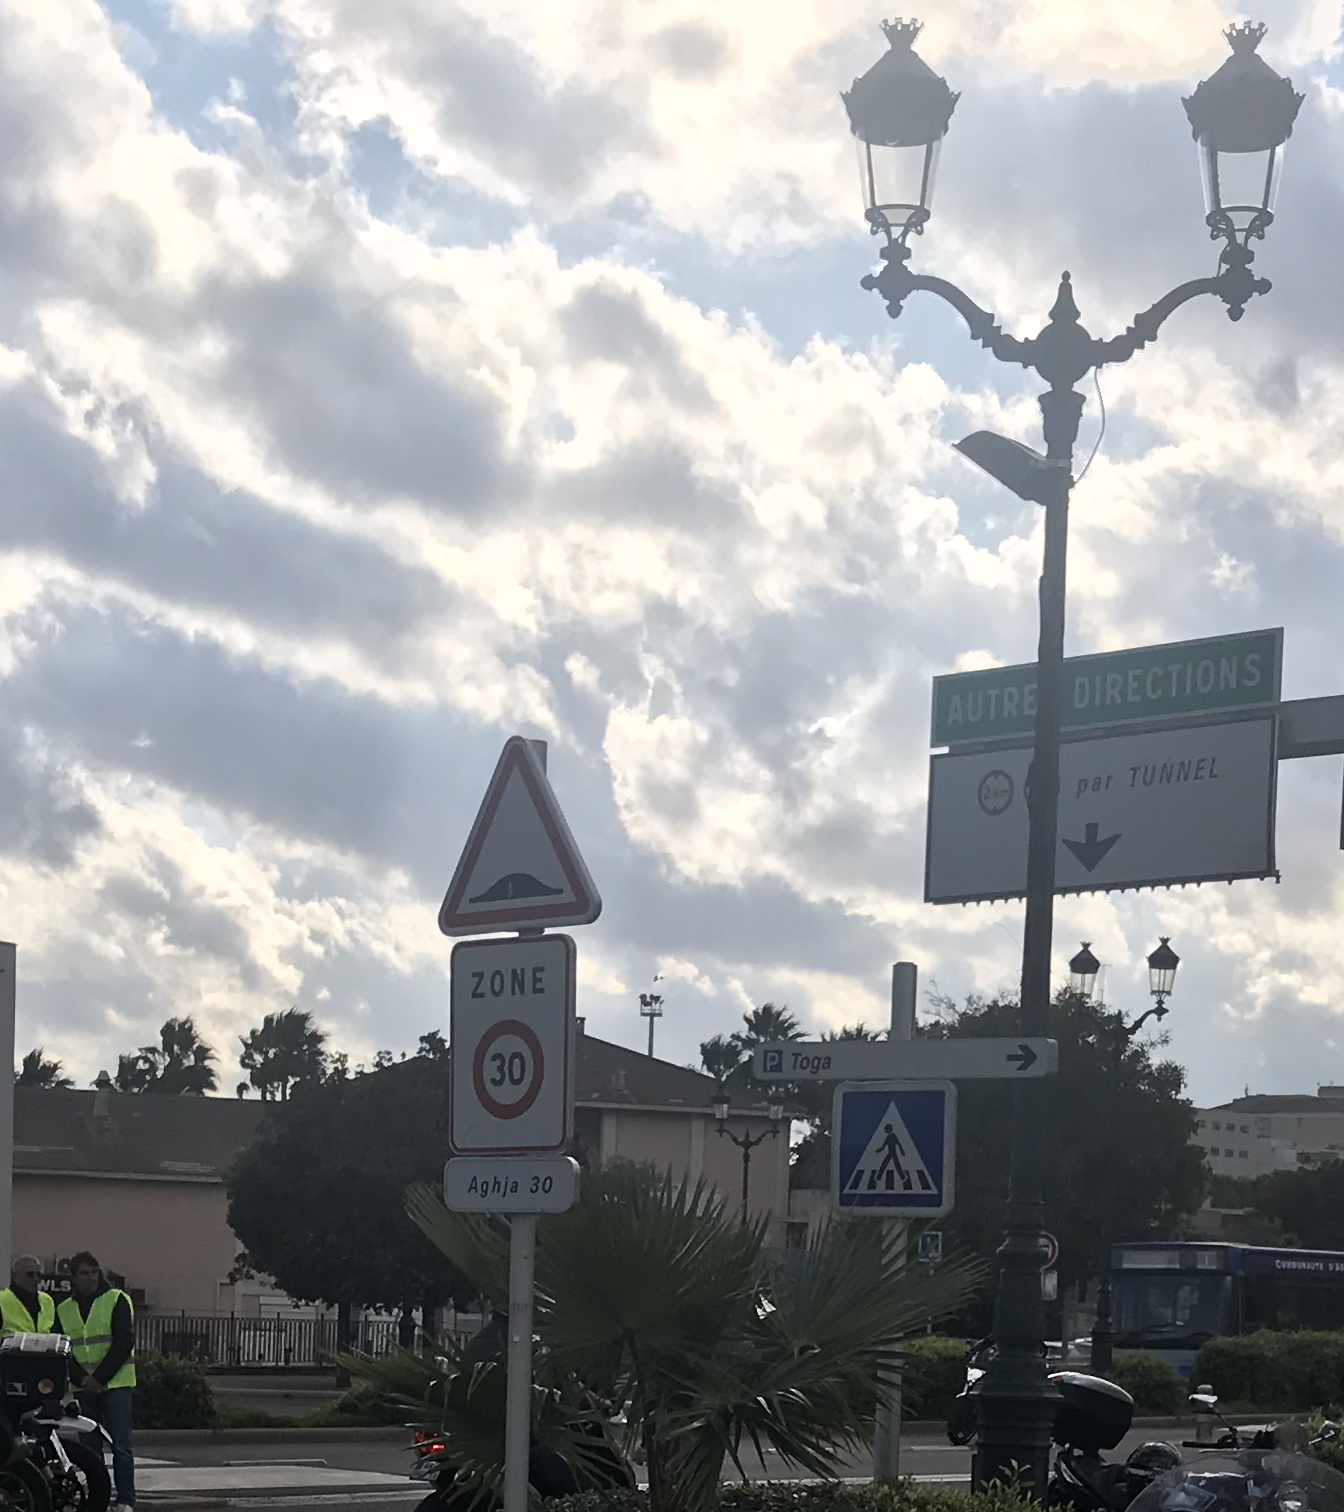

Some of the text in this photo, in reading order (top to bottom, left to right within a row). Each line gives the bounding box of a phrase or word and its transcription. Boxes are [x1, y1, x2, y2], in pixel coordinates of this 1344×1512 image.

[946, 652, 1262, 727] AUTRE DIRECTIONS
[1075, 774, 1114, 799] par
[1128, 756, 1219, 788] TUNNEL
[471, 966, 546, 999] ZONE
[490, 1051, 526, 1087] 30
[791, 1052, 832, 1075] Toga
[467, 1175, 554, 1199] Aghja 30
